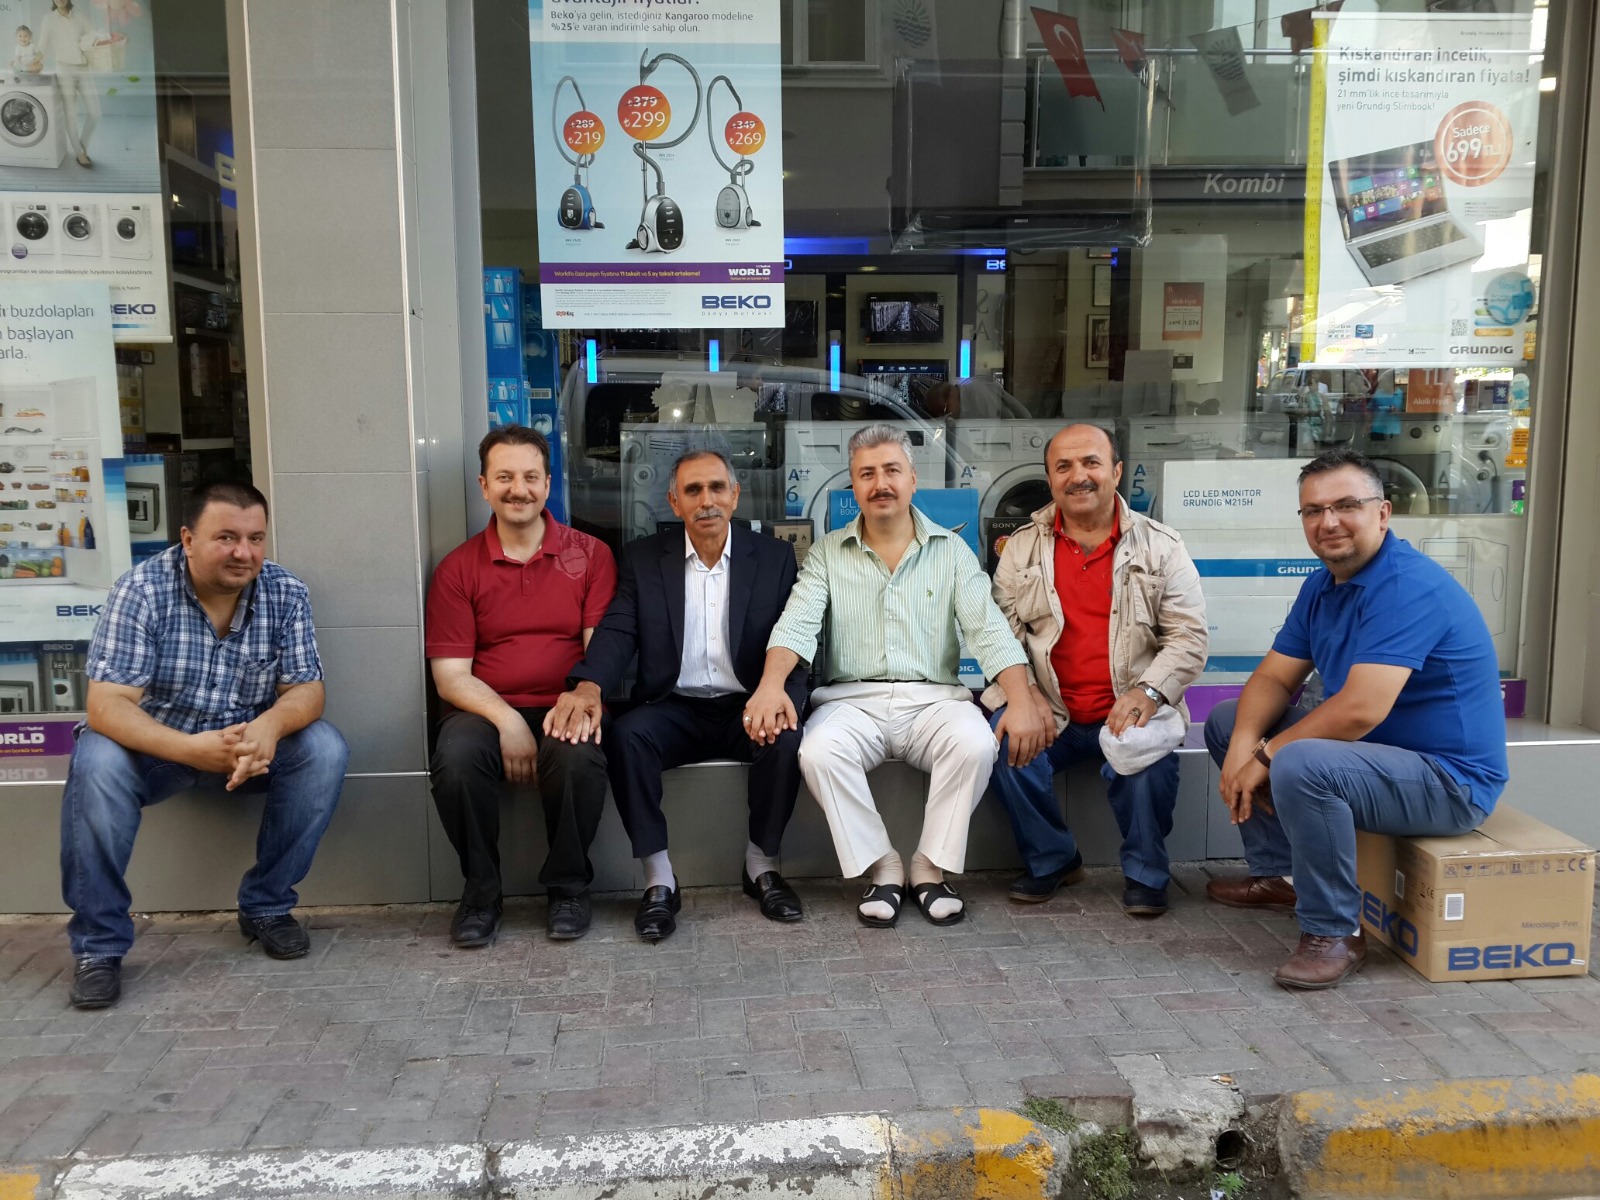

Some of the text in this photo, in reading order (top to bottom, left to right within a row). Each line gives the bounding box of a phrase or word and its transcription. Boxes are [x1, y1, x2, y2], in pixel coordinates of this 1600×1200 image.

[590, 11, 614, 21] gelin,
[665, 12, 709, 22] Kangaroo
[711, 12, 753, 20] modeline
[610, 23, 650, 31] indirimle
[652, 24, 676, 33] sahip
[678, 24, 700, 32] olun.
[1338, 67, 1530, 86] şimdi kıskandıran fiyata!
[1337, 89, 1347, 98] 21
[1382, 90, 1400, 98] ince
[1337, 101, 1436, 112] yeni Grundig Slimbook!
[1452, 124, 1492, 138] Sadece
[1446, 137, 1482, 163] 699
[1203, 173, 1286, 194] Kombi
[728, 268, 771, 276] WORLD
[701, 295, 772, 309] BEKO
[10, 304, 94, 320] buzdolapları
[7, 325, 74, 343] başlayan
[1449, 345, 1514, 355] GRUNDIG
[786, 485, 799, 503] 6
[1131, 479, 1145, 497] 5
[1183, 489, 1262, 498] LCD LED MONITOR
[840, 497, 860, 508] UL
[1183, 498, 1253, 507] GRUNDIG M215H
[56, 604, 103, 617] BEK
[43, 643, 74, 651] BEKO
[1356, 884, 1419, 958] EKO
[1447, 942, 1576, 972] BEKO
